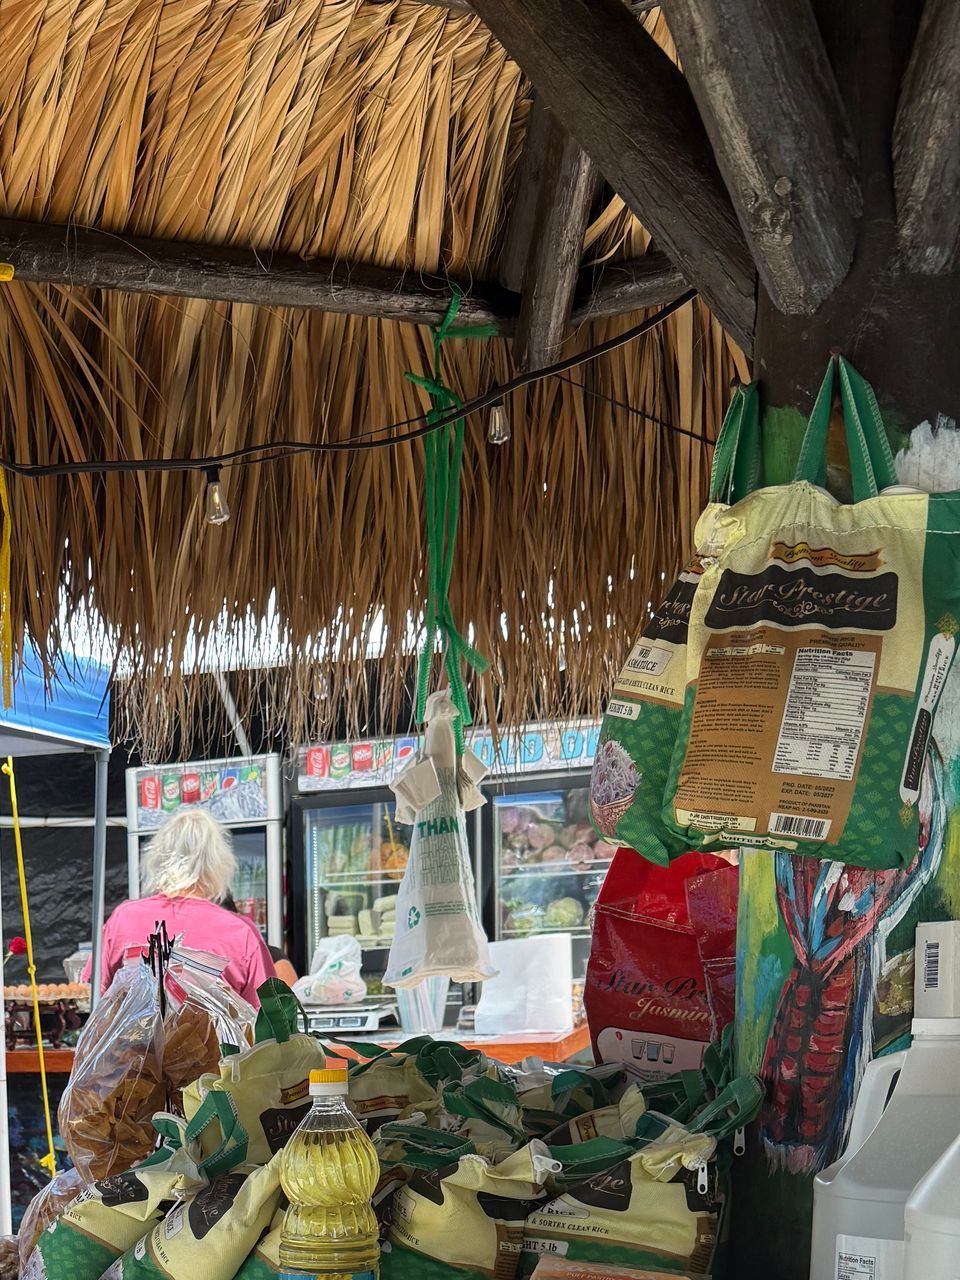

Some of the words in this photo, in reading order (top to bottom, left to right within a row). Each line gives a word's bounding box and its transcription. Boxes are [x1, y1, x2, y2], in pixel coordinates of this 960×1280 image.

[720, 583, 774, 605] Star
[775, 578, 888, 610] Prestige
[838, 641, 866, 649] QUALITY
[660, 685, 676, 696] RICE
[473, 733, 544, 766] OLD
[417, 815, 459, 839] THAN
[540, 1218, 567, 1230] SORTEX
[567, 1223, 591, 1232] CLEAN
[591, 1226, 610, 1235] RICE
[520, 1239, 538, 1252] GHT
[548, 1242, 558, 1252] lb
[160, 1250, 170, 1265] RICE
[839, 1255, 858, 1264] Nutrition
[566, 1271, 586, 1279] PUFF
